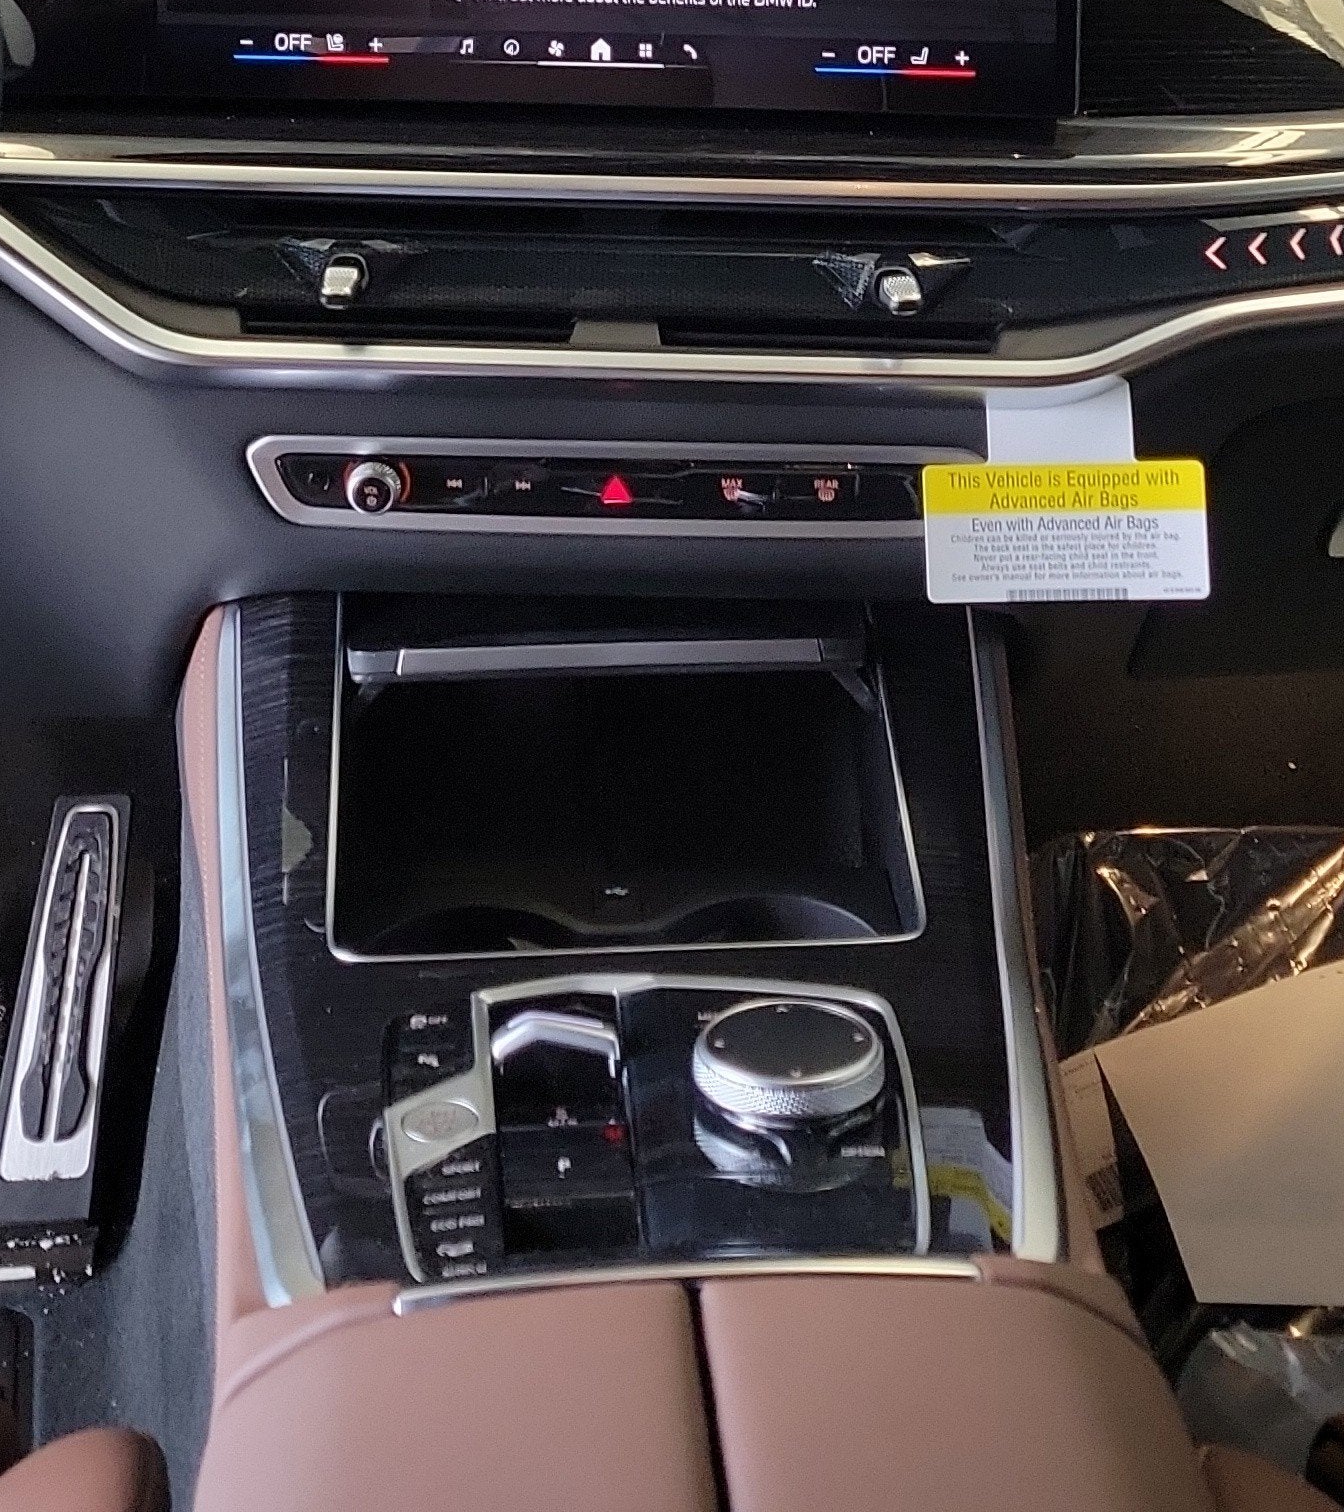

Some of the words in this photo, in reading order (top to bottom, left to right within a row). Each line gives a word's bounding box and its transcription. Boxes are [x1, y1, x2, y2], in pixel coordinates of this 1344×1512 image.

[274, 32, 313, 51] OFF
[857, 45, 897, 65] OFF
[721, 477, 743, 489] MAX
[814, 478, 839, 489] REAR
[948, 472, 981, 489] This
[986, 471, 1042, 488] Vehicle
[1066, 469, 1141, 490] Equipped
[1146, 469, 1180, 486] with
[990, 492, 1066, 509] Advanced
[1071, 491, 1094, 508] Air
[1100, 491, 1139, 510] Bags
[972, 517, 1002, 532] Even
[1006, 517, 1033, 531] with
[1038, 516, 1100, 531] Advanced
[1105, 515, 1122, 530] Air
[1127, 515, 1160, 532] Bags
